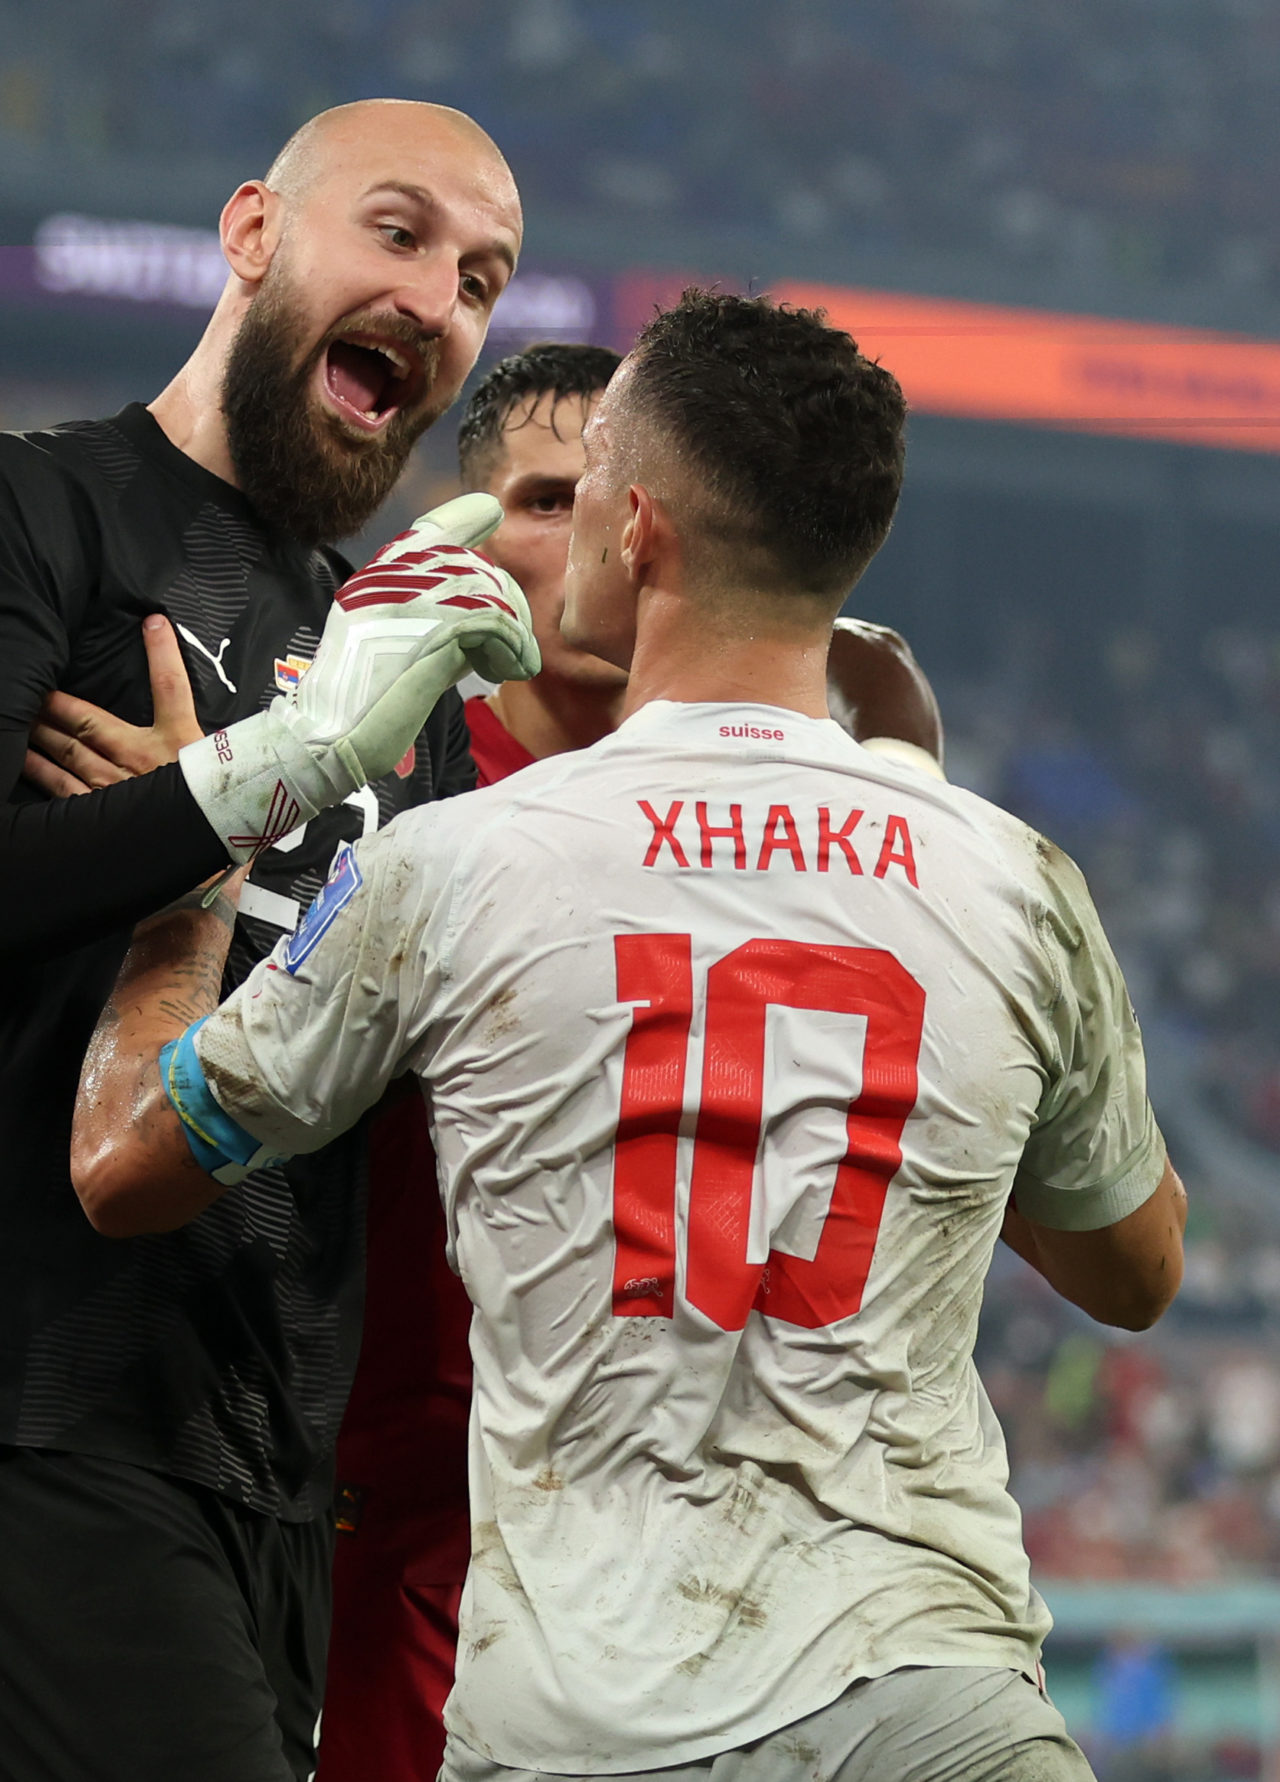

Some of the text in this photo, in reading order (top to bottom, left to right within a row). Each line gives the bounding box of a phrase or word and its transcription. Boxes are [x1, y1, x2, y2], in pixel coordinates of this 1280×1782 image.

[719, 722, 784, 741] suisse
[637, 800, 920, 889] XHAKA
[612, 932, 927, 1332] 10
